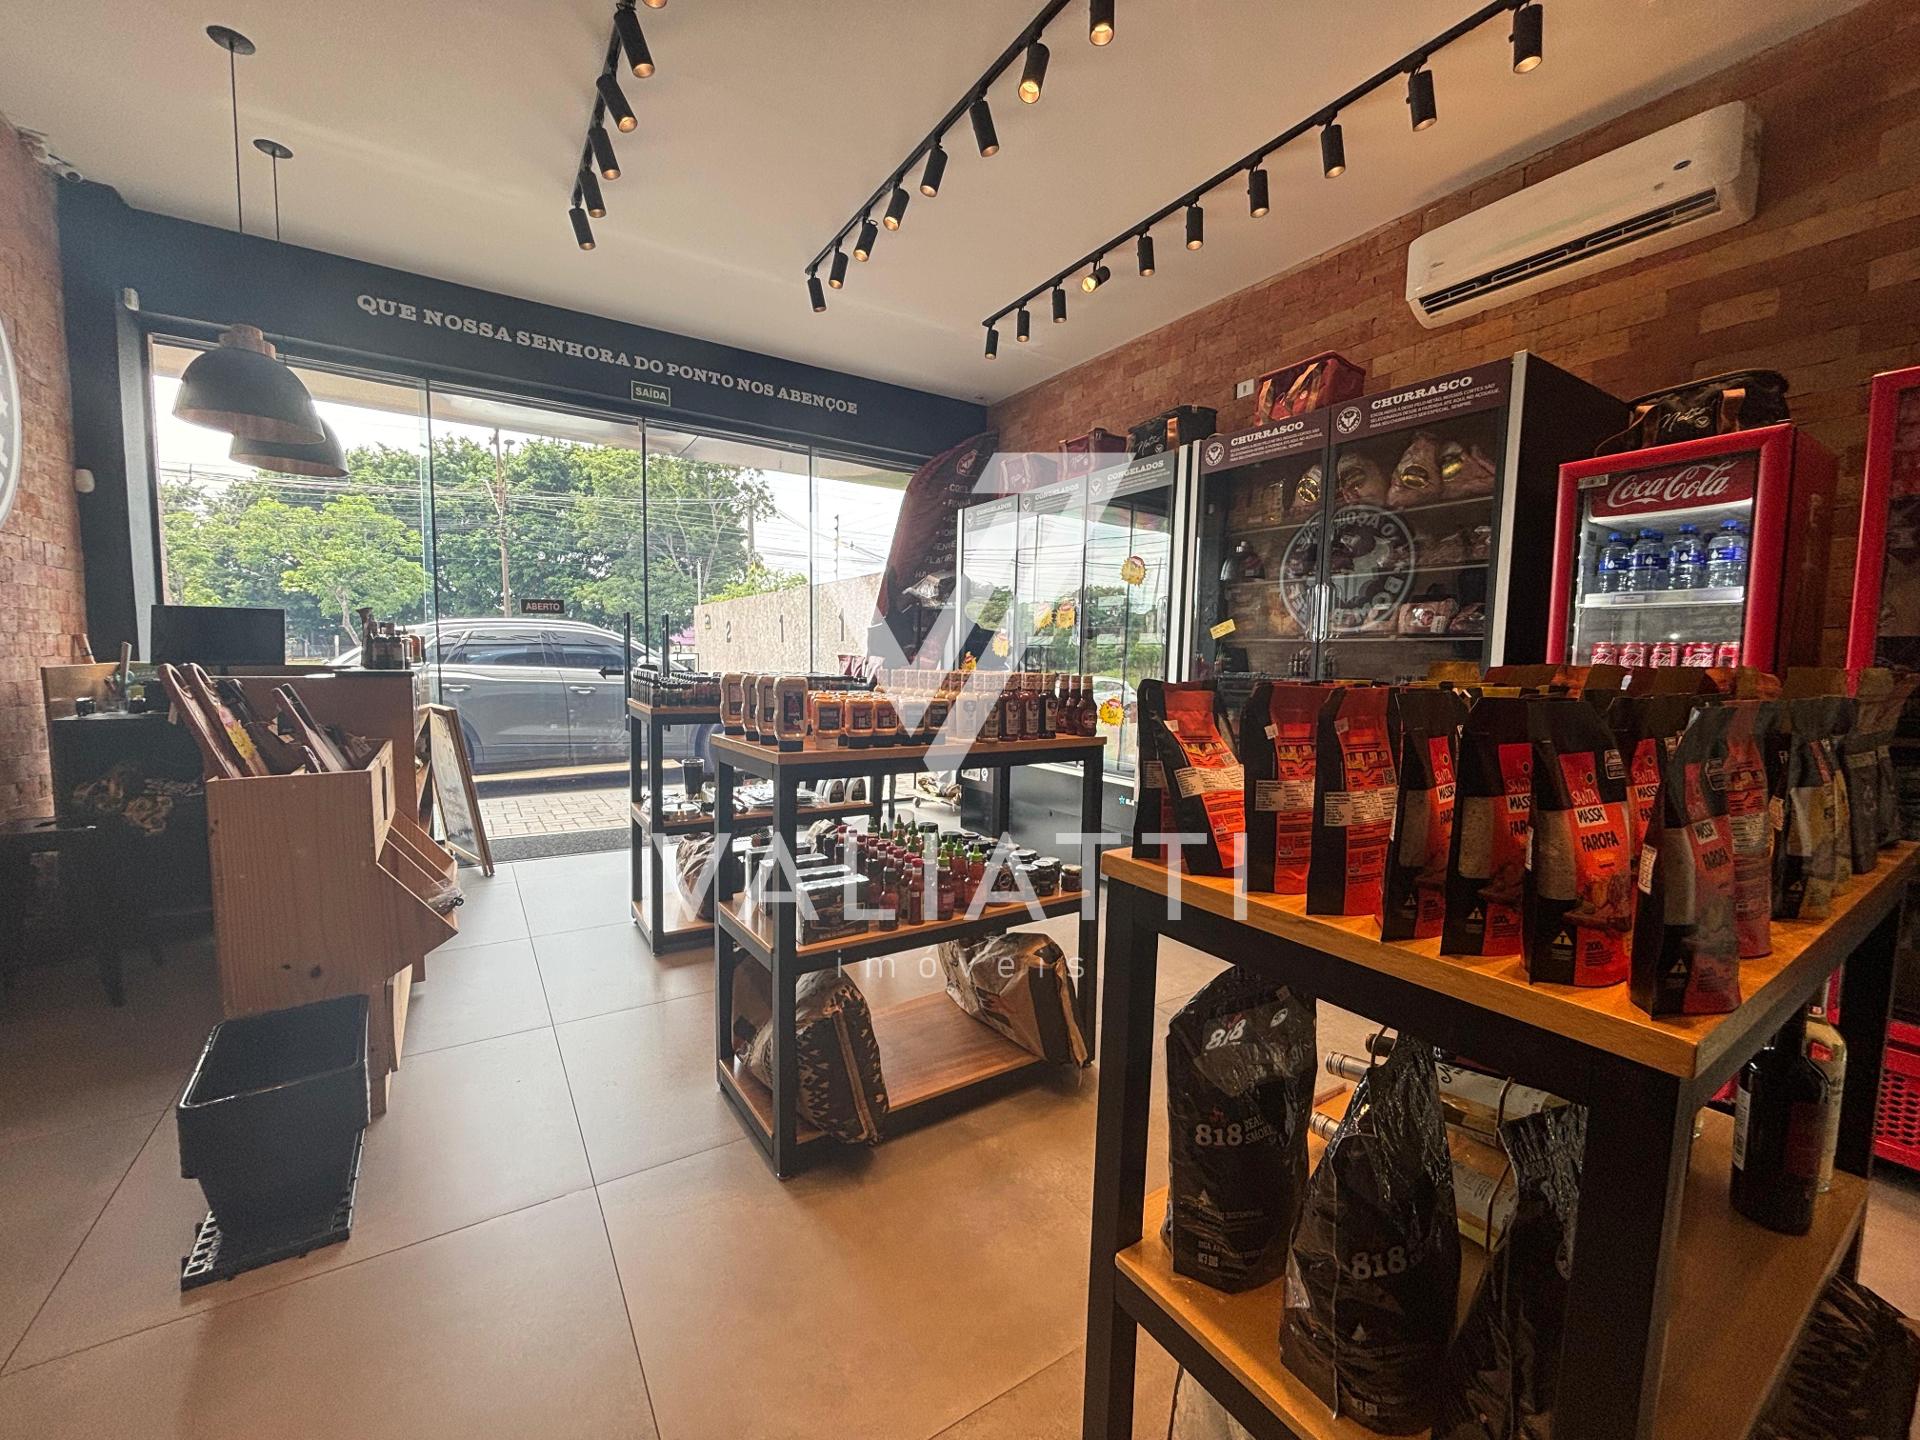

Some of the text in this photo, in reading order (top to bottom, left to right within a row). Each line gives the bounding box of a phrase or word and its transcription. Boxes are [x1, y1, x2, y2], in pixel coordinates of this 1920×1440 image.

[357, 294, 858, 415] QUE NOSSA SENHORA DO PONTO NOS ABENÇOE
[635, 386, 667, 401] SAÍDA
[1370, 376, 1473, 410] CHURRASCO
[1230, 421, 1305, 446] CHURRASCO
[1107, 460, 1164, 481] CONGELADOS
[1035, 483, 1080, 501] CONGELADOS
[1607, 460, 1739, 508] Coca-Cola
[525, 602, 560, 611] ABERTO
[1509, 795, 1531, 811] MASS
[1571, 787, 1600, 806] SANTA
[1577, 807, 1606, 824] MASSA
[1581, 831, 1620, 852] FAROFA
[1205, 1019, 1247, 1051] 818
[1194, 1123, 1243, 1146] 818
[1351, 1245, 1408, 1280] 818
